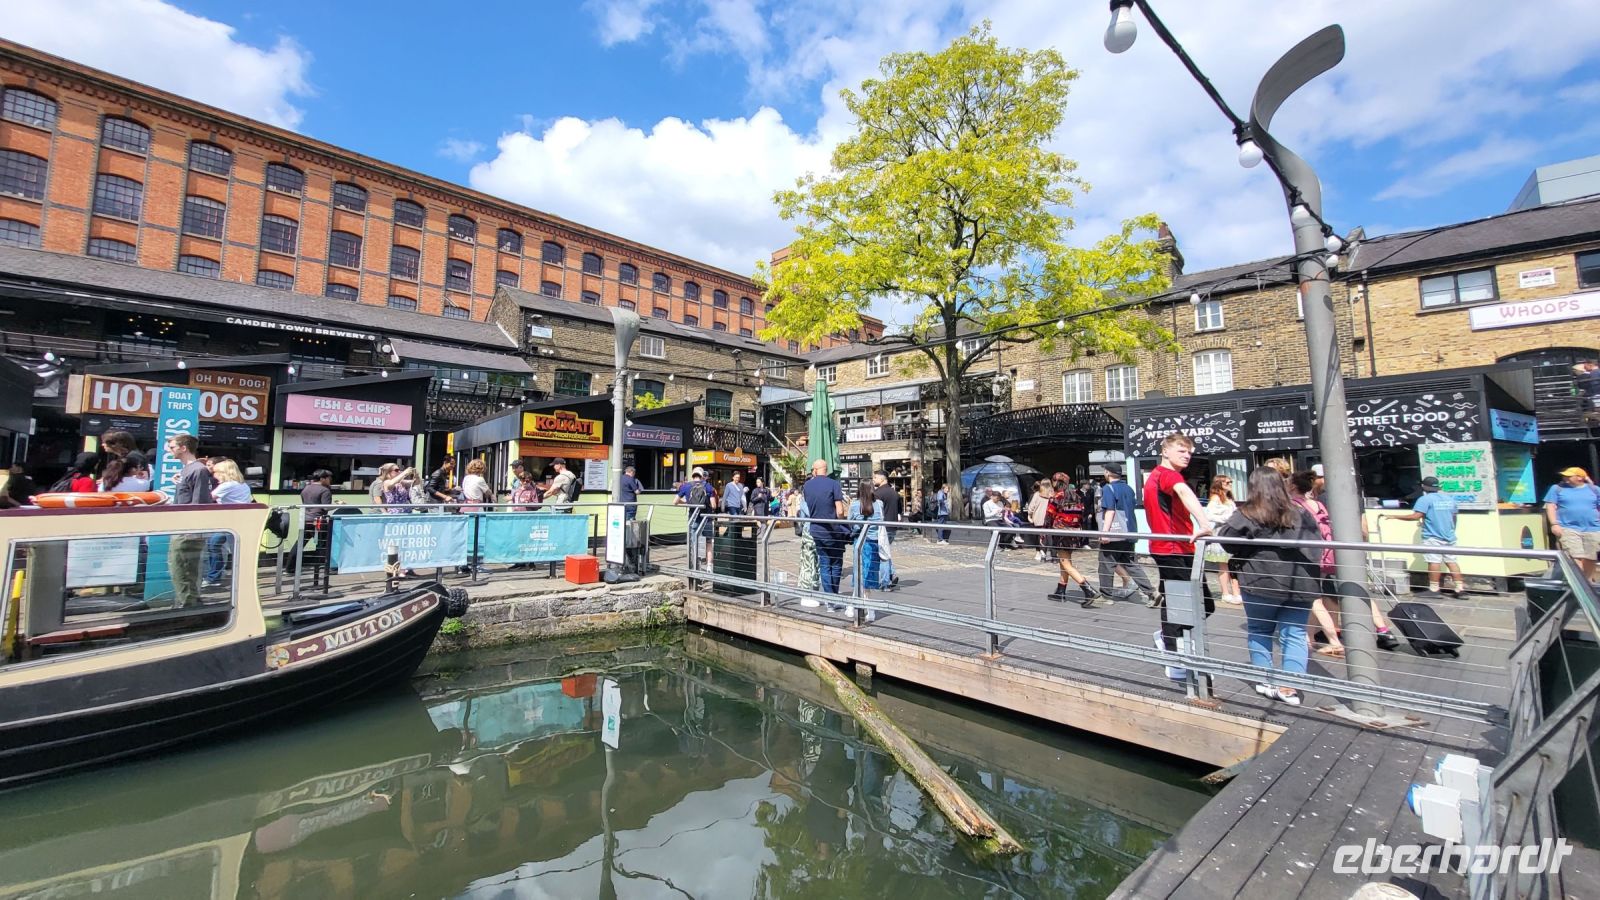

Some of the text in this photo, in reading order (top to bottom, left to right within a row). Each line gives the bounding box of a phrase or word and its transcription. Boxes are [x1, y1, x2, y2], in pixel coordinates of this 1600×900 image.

[1500, 299, 1580, 319] WHOOPS
[226, 317, 366, 339] CAMDEN TOWN BREWERY
[195, 372, 266, 389] OH MY DOG!
[93, 380, 259, 421] HOT OGS
[168, 391, 193, 400] BOAT
[167, 401, 193, 411] TRIPS
[314, 398, 392, 415] FISH & CHIPS
[319, 412, 386, 427] CALAMARI
[535, 415, 595, 436] KOLKATI
[1257, 419, 1294, 428] CAMDEN
[1347, 411, 1449, 427] STREET FOOD
[626, 430, 654, 440] CAMDEN
[672, 434, 681, 442] CO
[1181, 427, 1215, 437] YARD
[1258, 426, 1294, 434] MARKET
[1424, 449, 1485, 463] CHEESY
[384, 523, 432, 536] LONDON
[377, 536, 438, 550] WATERBUS
[380, 549, 434, 563] CMPANY
[322, 609, 405, 650] MILTON
